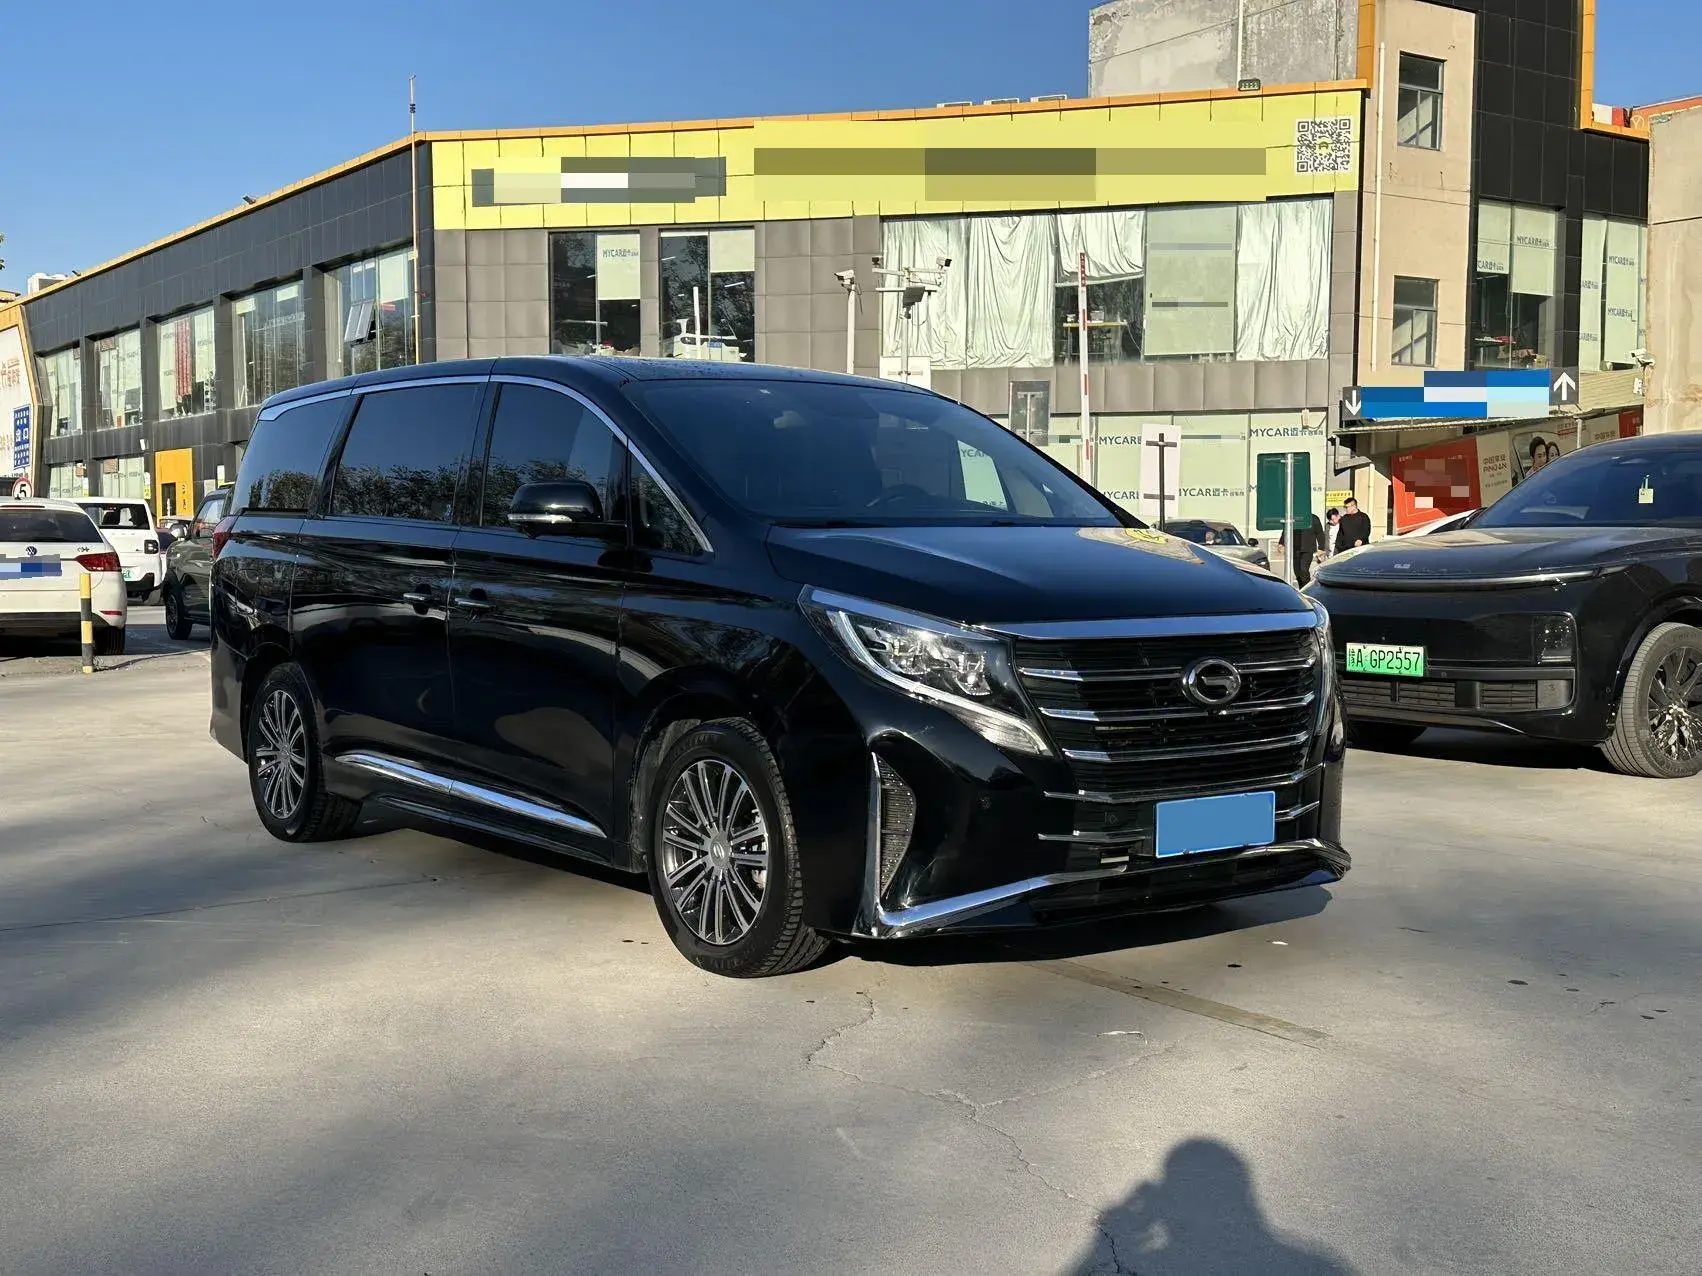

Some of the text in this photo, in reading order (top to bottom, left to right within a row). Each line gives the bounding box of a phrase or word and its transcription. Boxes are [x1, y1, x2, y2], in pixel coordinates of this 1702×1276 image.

[1250, 428, 1290, 436] MYCAR
[1100, 436, 1138, 444] MYCAR
[19, 484, 27, 498] 5
[1370, 650, 1421, 671] GP2557
